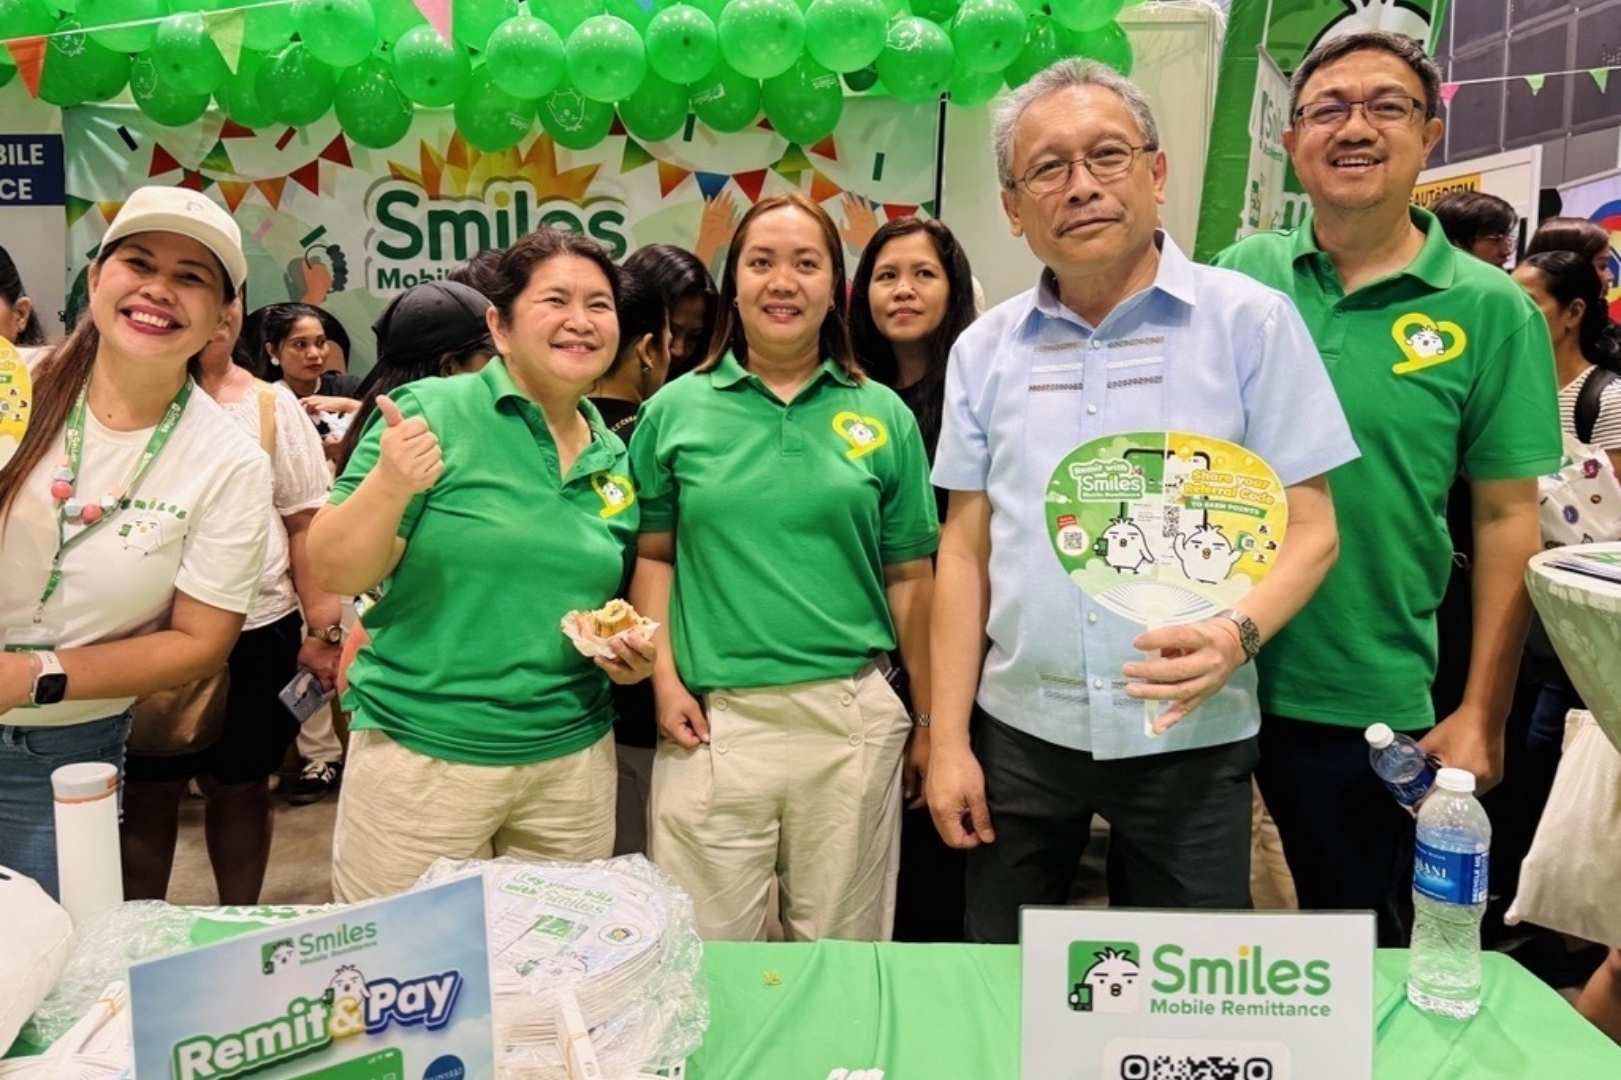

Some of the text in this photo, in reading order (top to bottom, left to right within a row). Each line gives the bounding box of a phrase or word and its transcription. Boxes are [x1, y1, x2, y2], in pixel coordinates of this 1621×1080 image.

[1082, 474, 1140, 491] Smiles
[299, 922, 377, 955] Smiles
[1151, 943, 1332, 996] Smiles
[1150, 998, 1331, 1017] Mobile Remittance
[177, 1001, 327, 1080] Remit
[368, 975, 456, 1022] Pay
